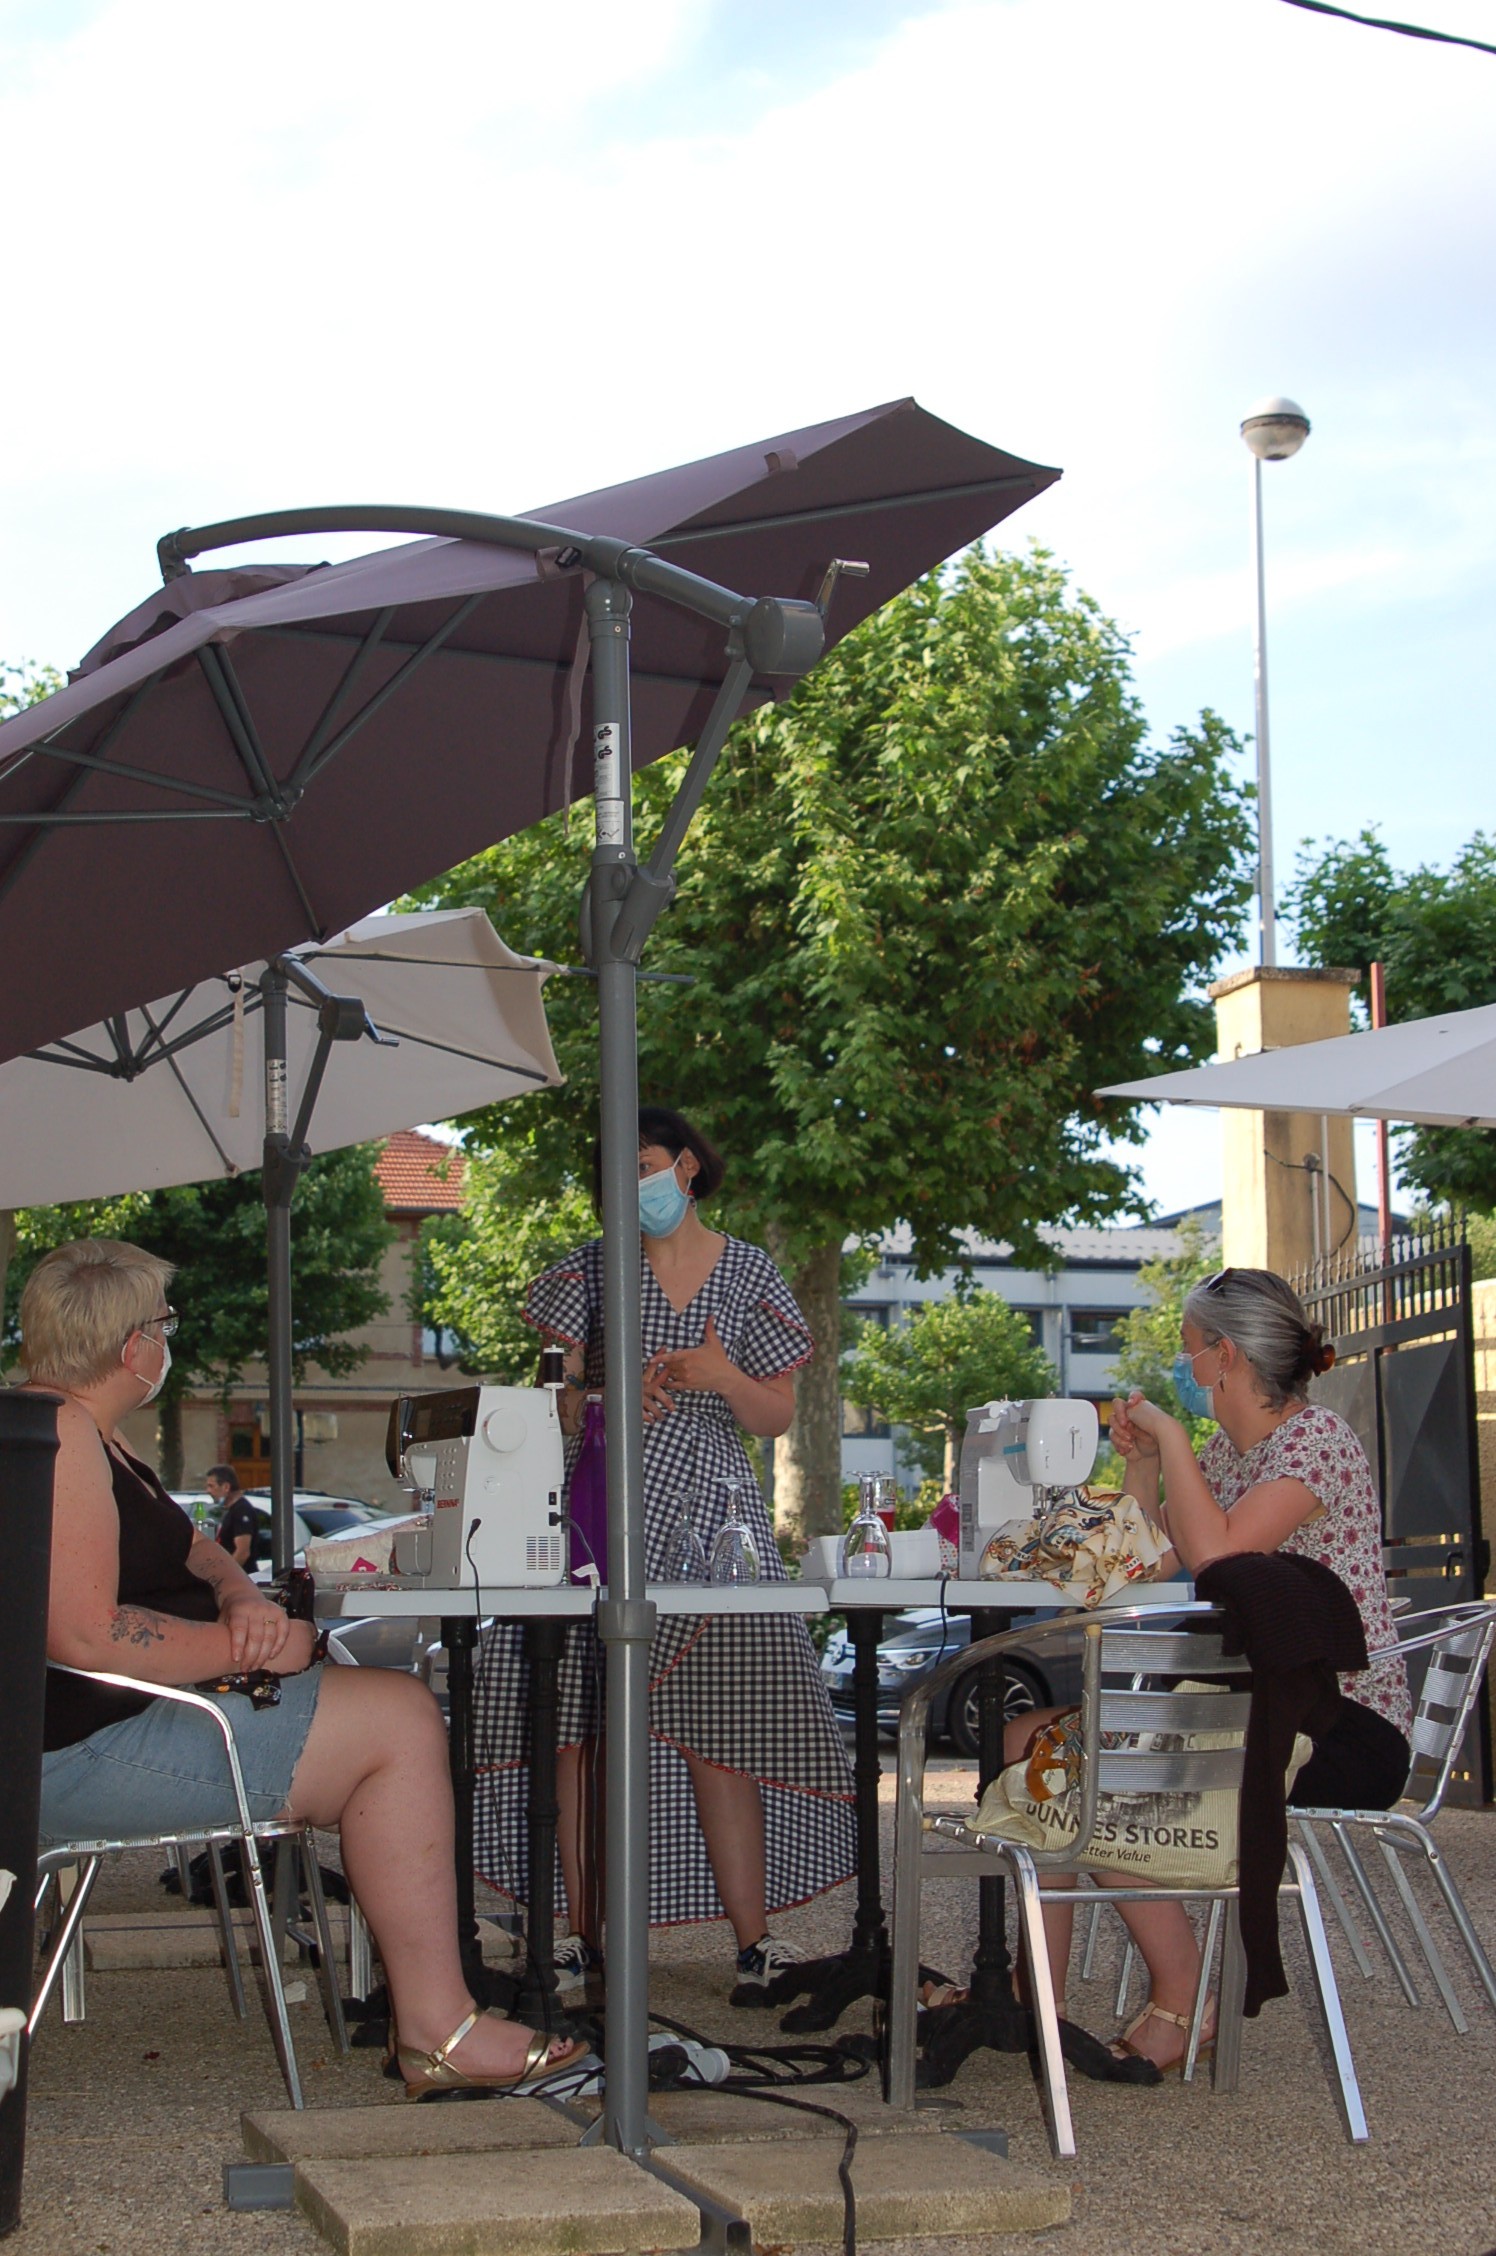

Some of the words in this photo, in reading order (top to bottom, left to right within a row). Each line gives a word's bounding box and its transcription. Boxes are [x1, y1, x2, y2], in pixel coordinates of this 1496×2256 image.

[1125, 1824, 1219, 1850] STORES
[1082, 1847, 1113, 1859] etter
[1116, 1849, 1152, 1863] Value
